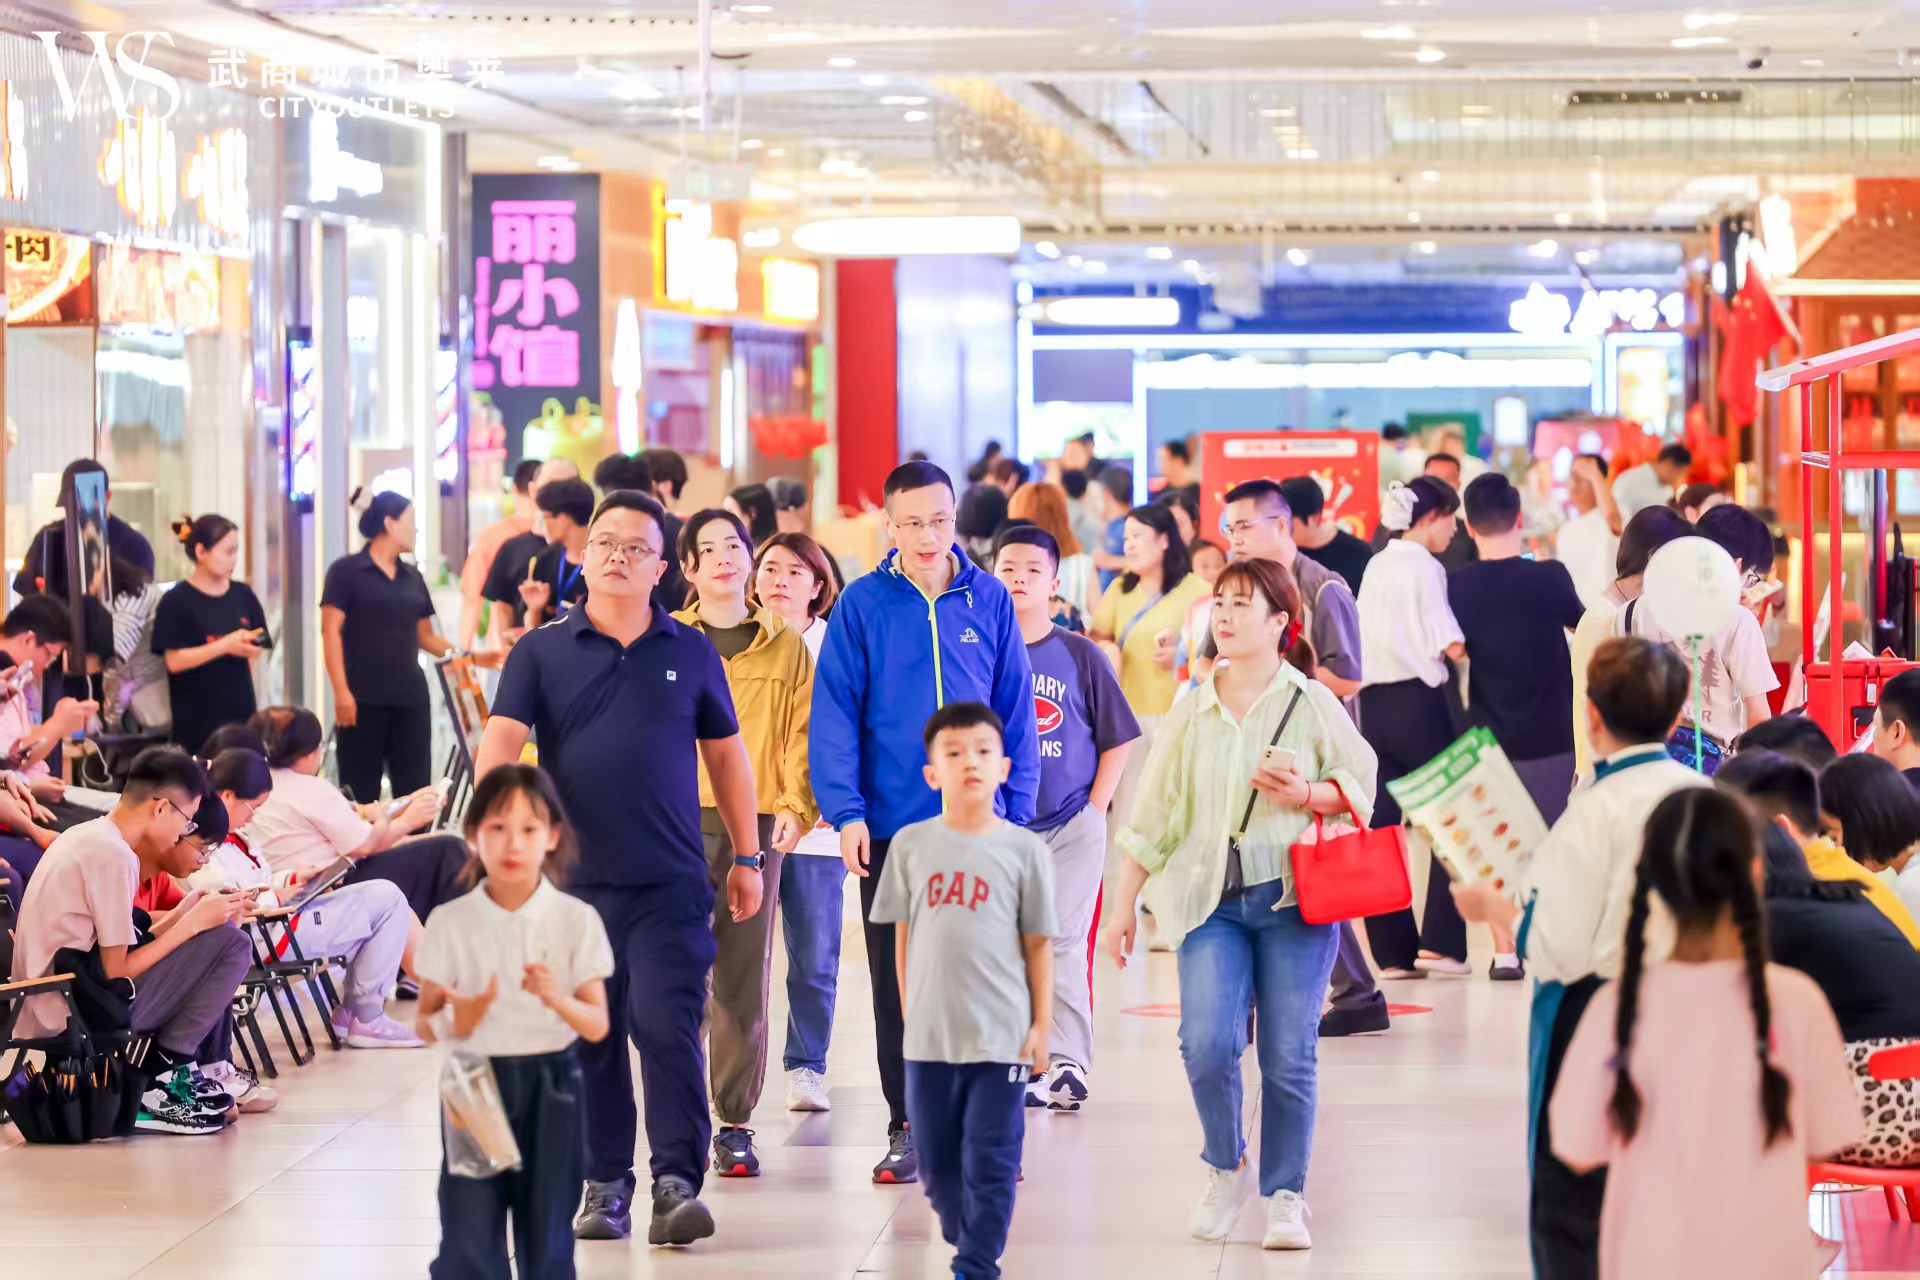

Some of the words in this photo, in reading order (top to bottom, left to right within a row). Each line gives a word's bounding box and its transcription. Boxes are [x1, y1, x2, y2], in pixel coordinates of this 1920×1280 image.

[6, 234, 51, 263] 肉
[490, 200, 580, 387] 丽小馆
[1036, 711, 1059, 726] al
[1040, 740, 1063, 758] NS
[928, 871, 990, 913] GAP
[1008, 1065, 1031, 1083] GA
